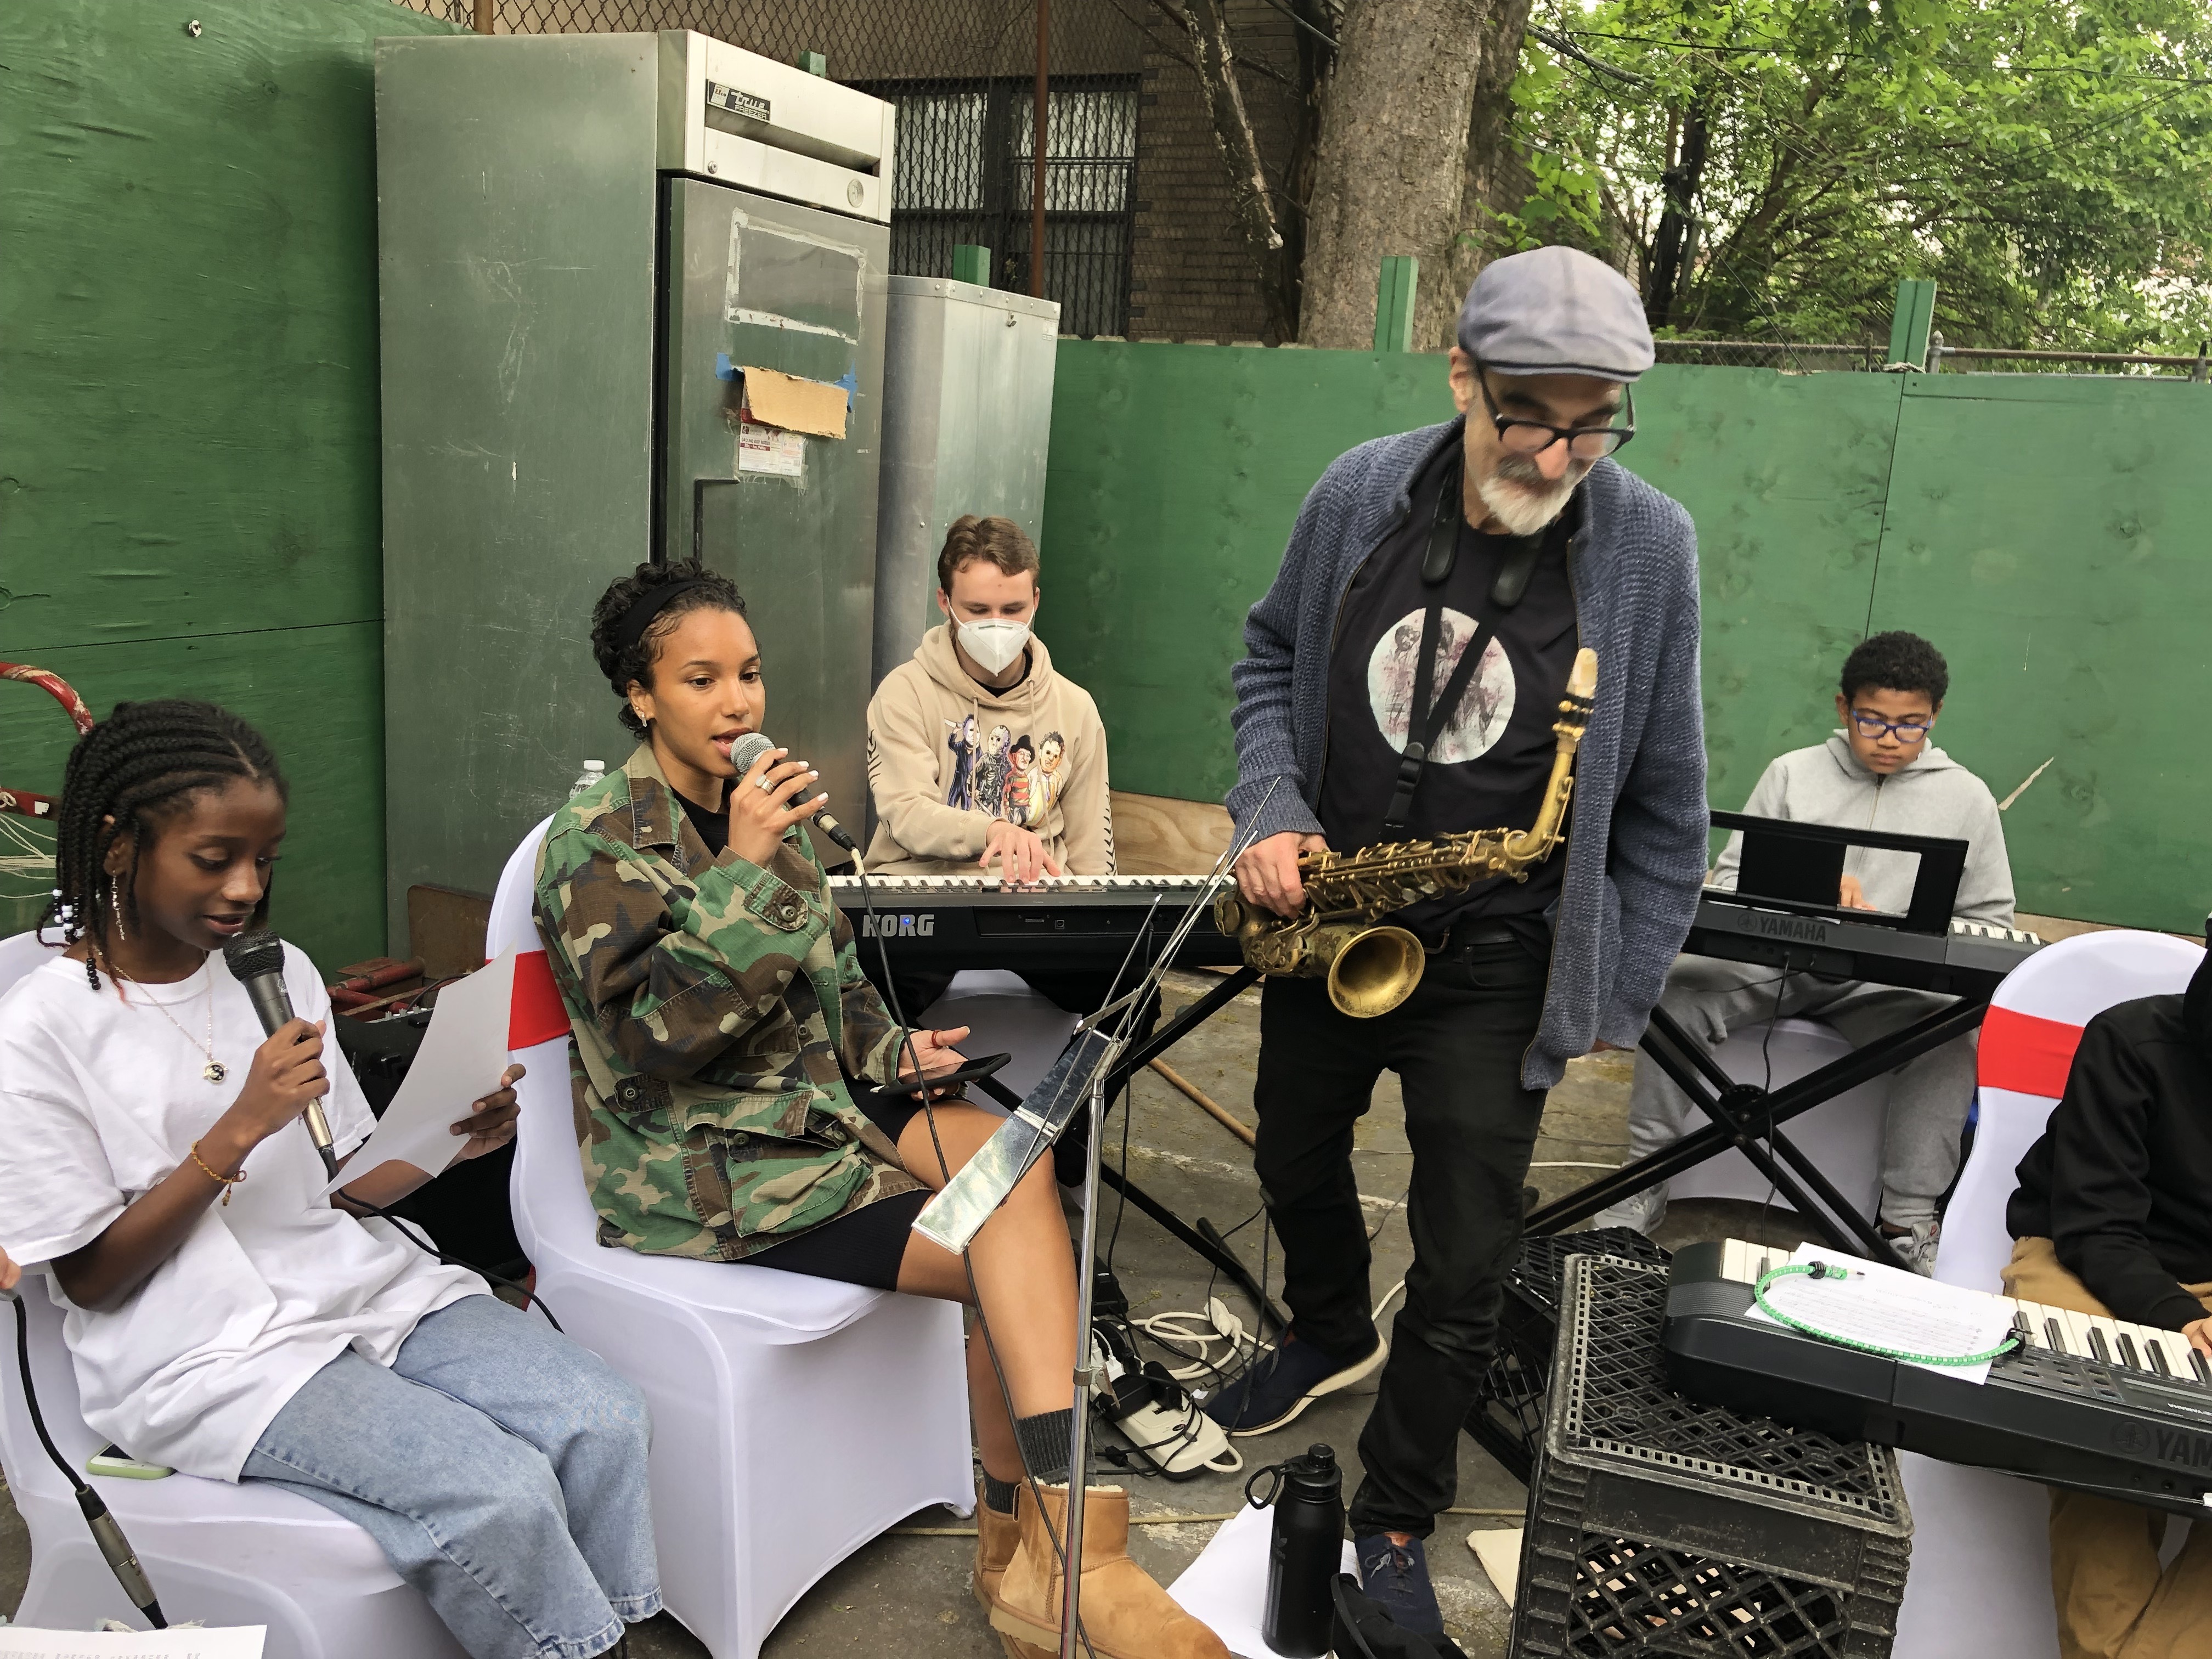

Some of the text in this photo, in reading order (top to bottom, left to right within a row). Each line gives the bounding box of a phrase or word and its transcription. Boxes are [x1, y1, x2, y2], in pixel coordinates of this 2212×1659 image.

[735, 104, 767, 120] FREEZER
[862, 914, 935, 937] KORG
[1760, 916, 1826, 943] YAMAHA
